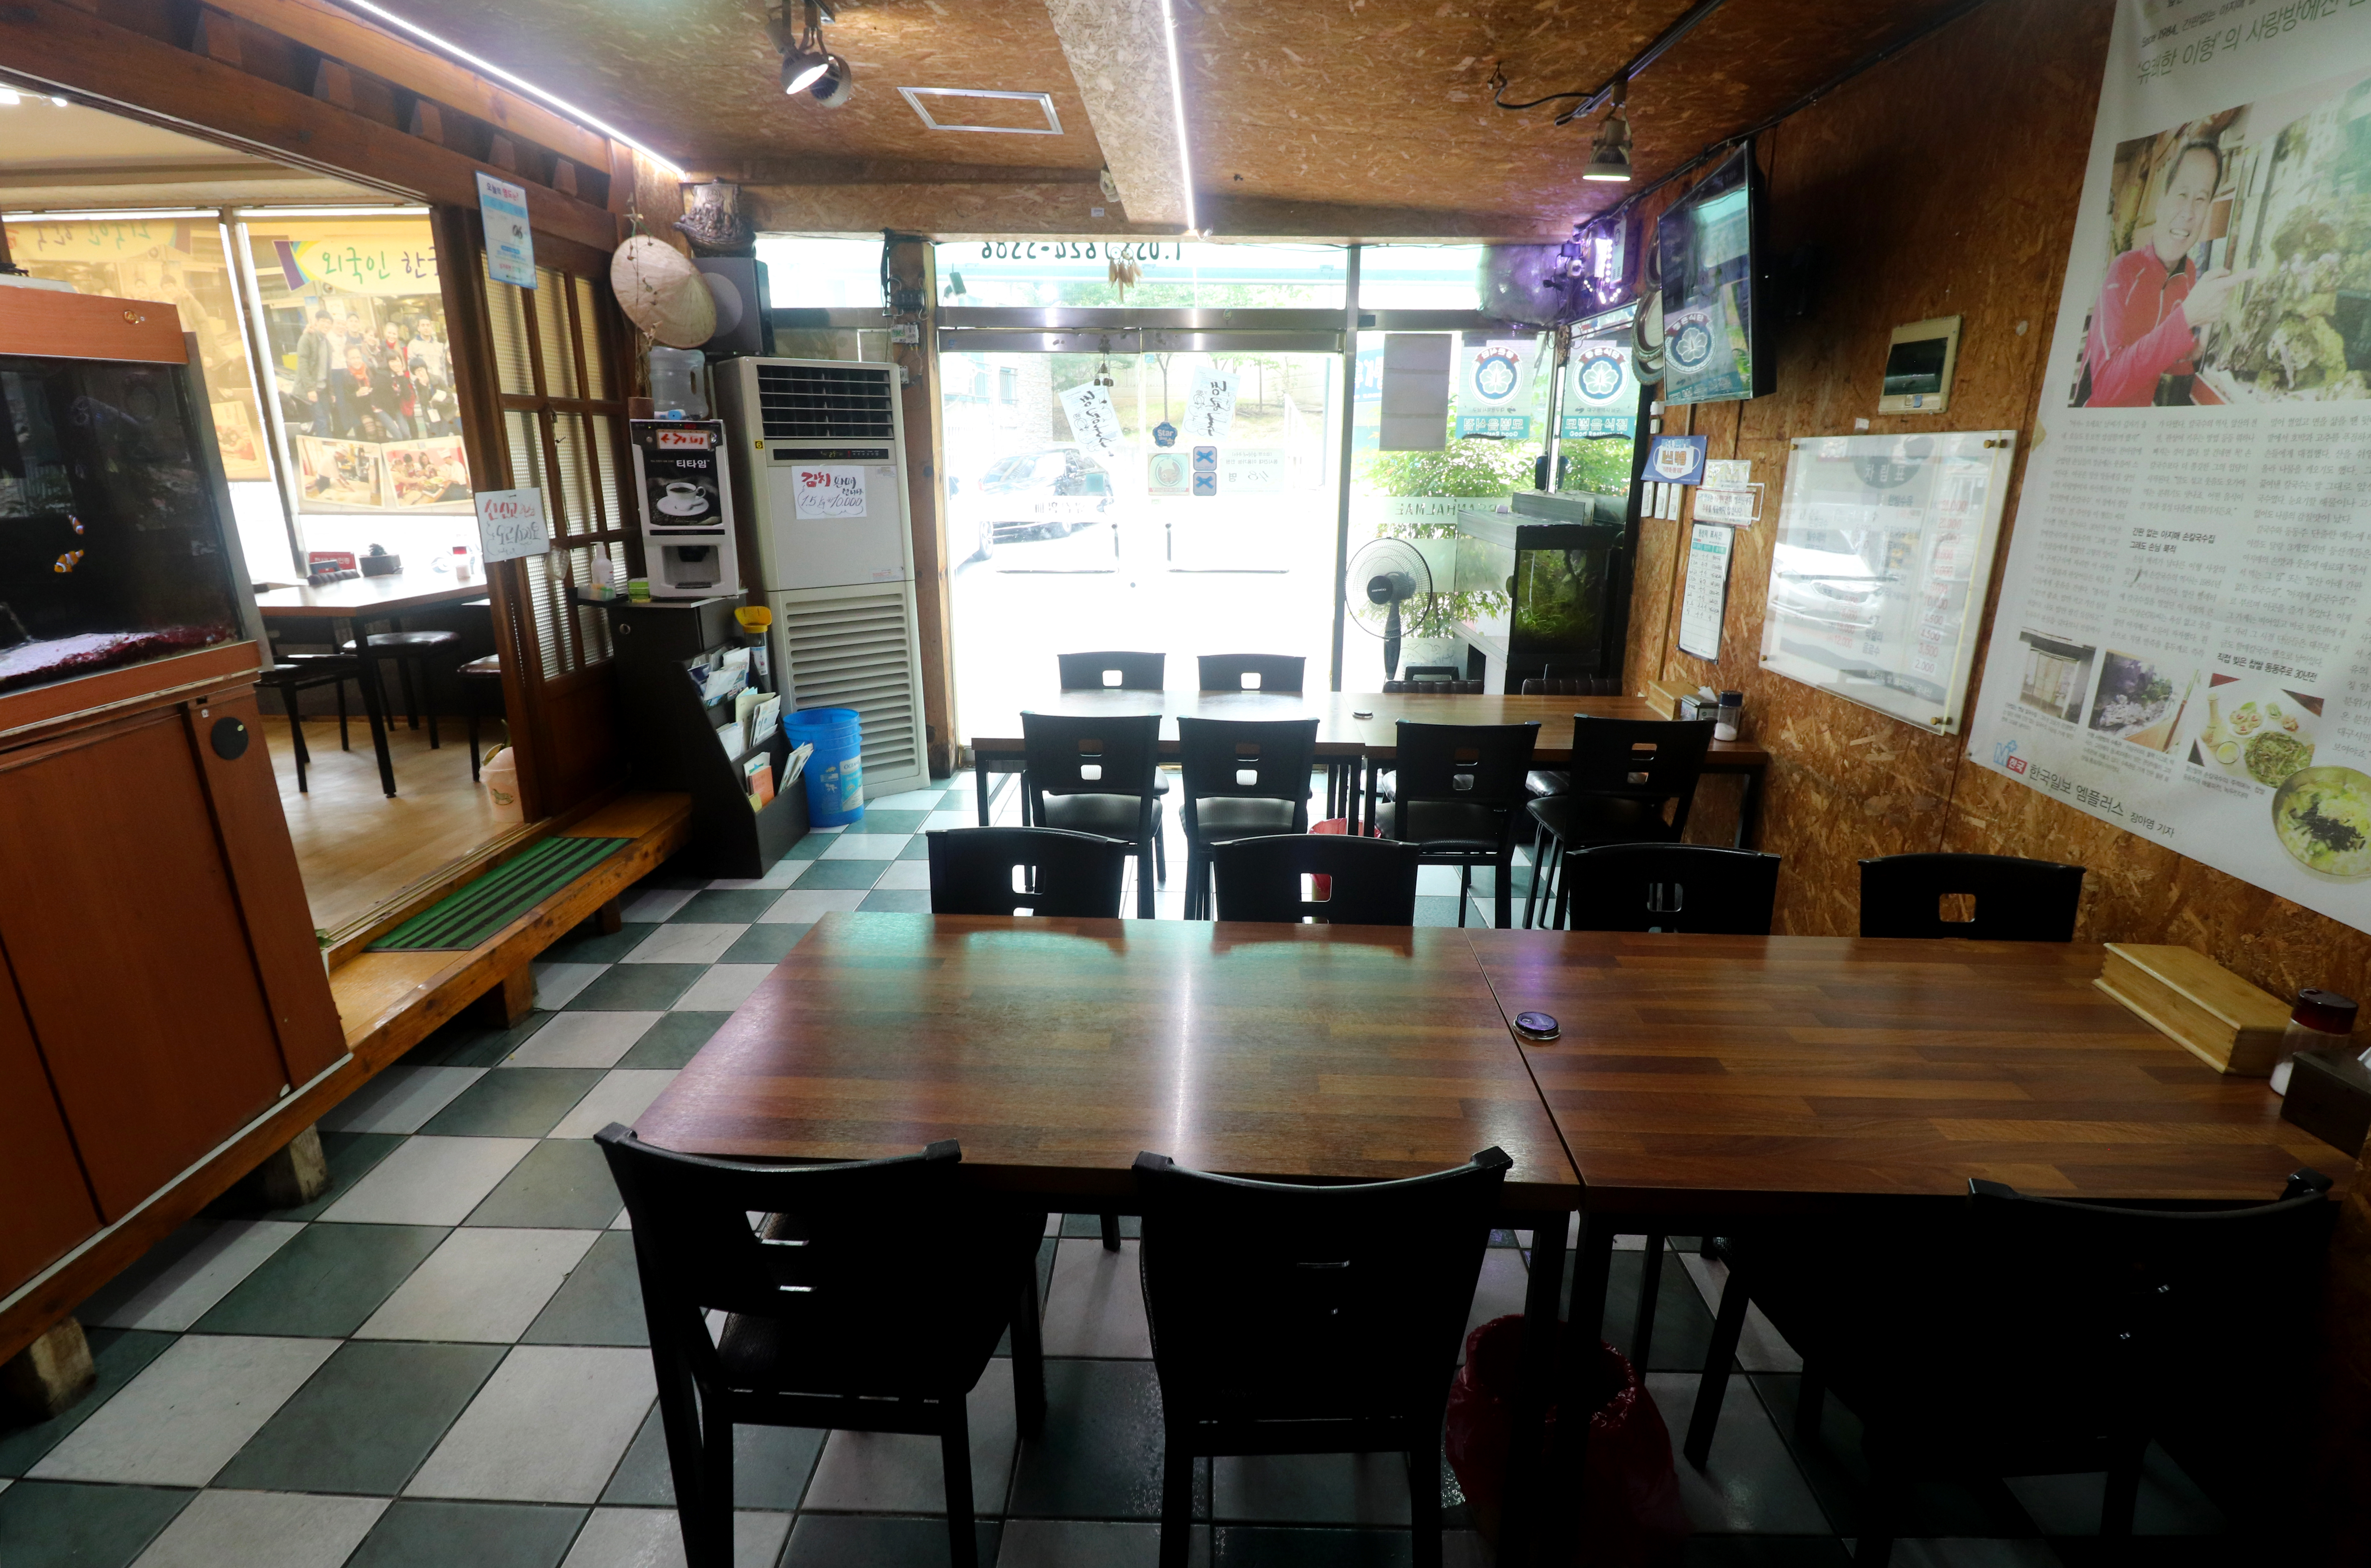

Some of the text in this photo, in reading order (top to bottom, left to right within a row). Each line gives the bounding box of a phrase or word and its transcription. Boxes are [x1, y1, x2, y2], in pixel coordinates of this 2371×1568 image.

[322, 246, 390, 283] 외국인
[1565, 418, 1628, 431] 모범음식점
[1157, 429, 1174, 437] Star
[2335, 449, 2352, 459] 산을
[801, 472, 856, 489] 김치 판매
[2325, 482, 2352, 491] 그대로
[2132, 527, 2216, 544] 간판 없는 아지매 손칼국수집
[2284, 527, 2309, 538] 동동주
[2340, 531, 2365, 542] 메뉴에
[2129, 541, 2147, 550] 그래도
[2148, 543, 2162, 552] 손님
[2242, 554, 2269, 564] 아지매의
[2296, 559, 2319, 570] 웃음에
[2234, 582, 2248, 593] 없는
[2263, 571, 2272, 579] 그
[2326, 579, 2342, 589] 아래
[2345, 581, 2363, 591] 간판
[2336, 612, 2352, 624] 이제
[2289, 621, 2304, 631] 바로
[2217, 653, 2318, 681] 직접 빚은 찹쌀 동동주로 30년전
[2029, 764, 2072, 795] 한국일보
[2076, 784, 2124, 816] 엠플러스
[2130, 812, 2155, 830] 장아영
[2157, 823, 2175, 838] 기자
